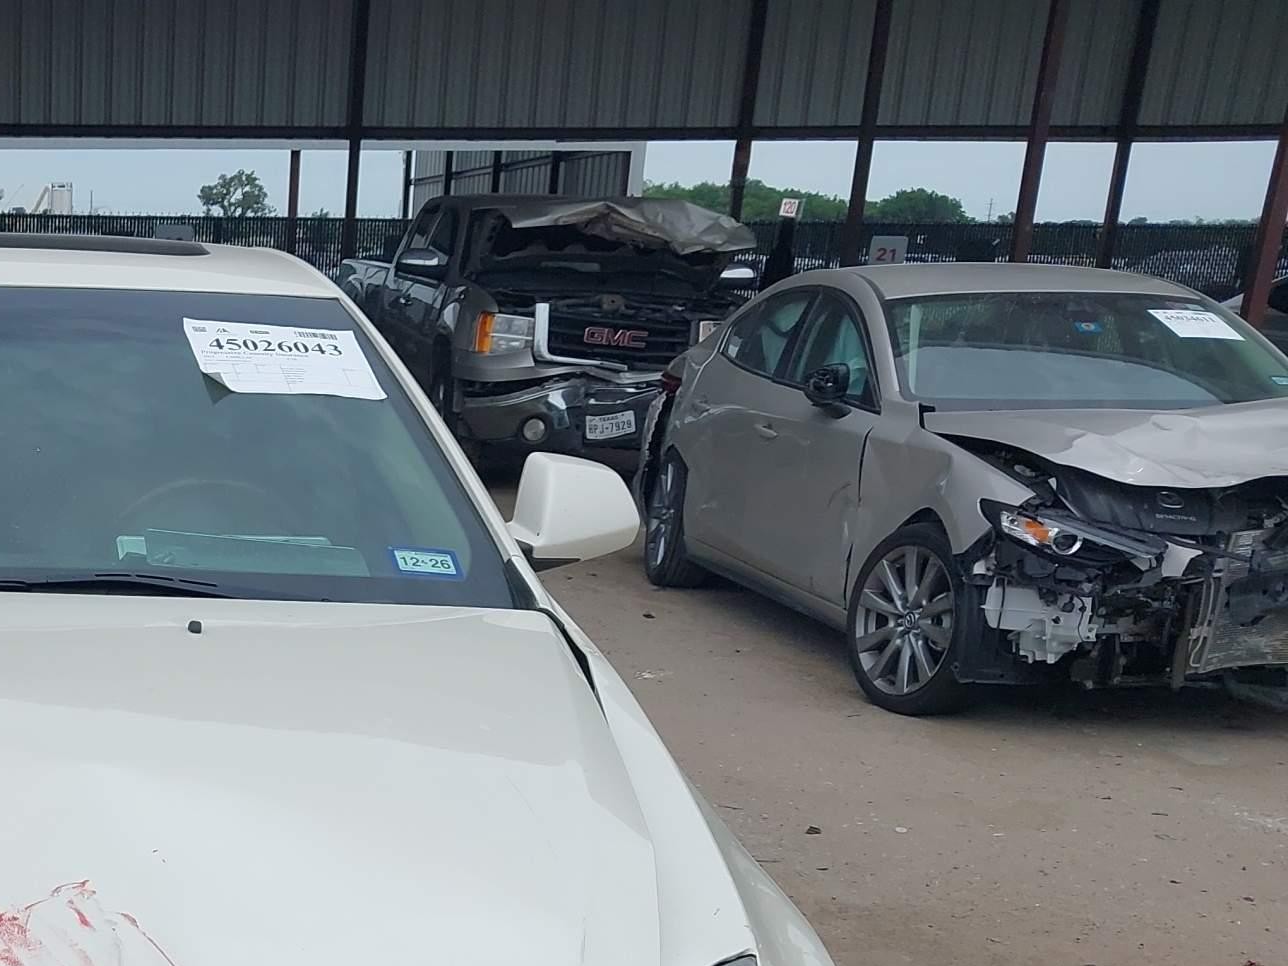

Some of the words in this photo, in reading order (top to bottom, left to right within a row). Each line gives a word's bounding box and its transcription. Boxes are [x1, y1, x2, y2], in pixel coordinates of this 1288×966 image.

[876, 248, 897, 262] 21
[583, 326, 649, 348] GMC
[209, 338, 343, 356] 45026043
